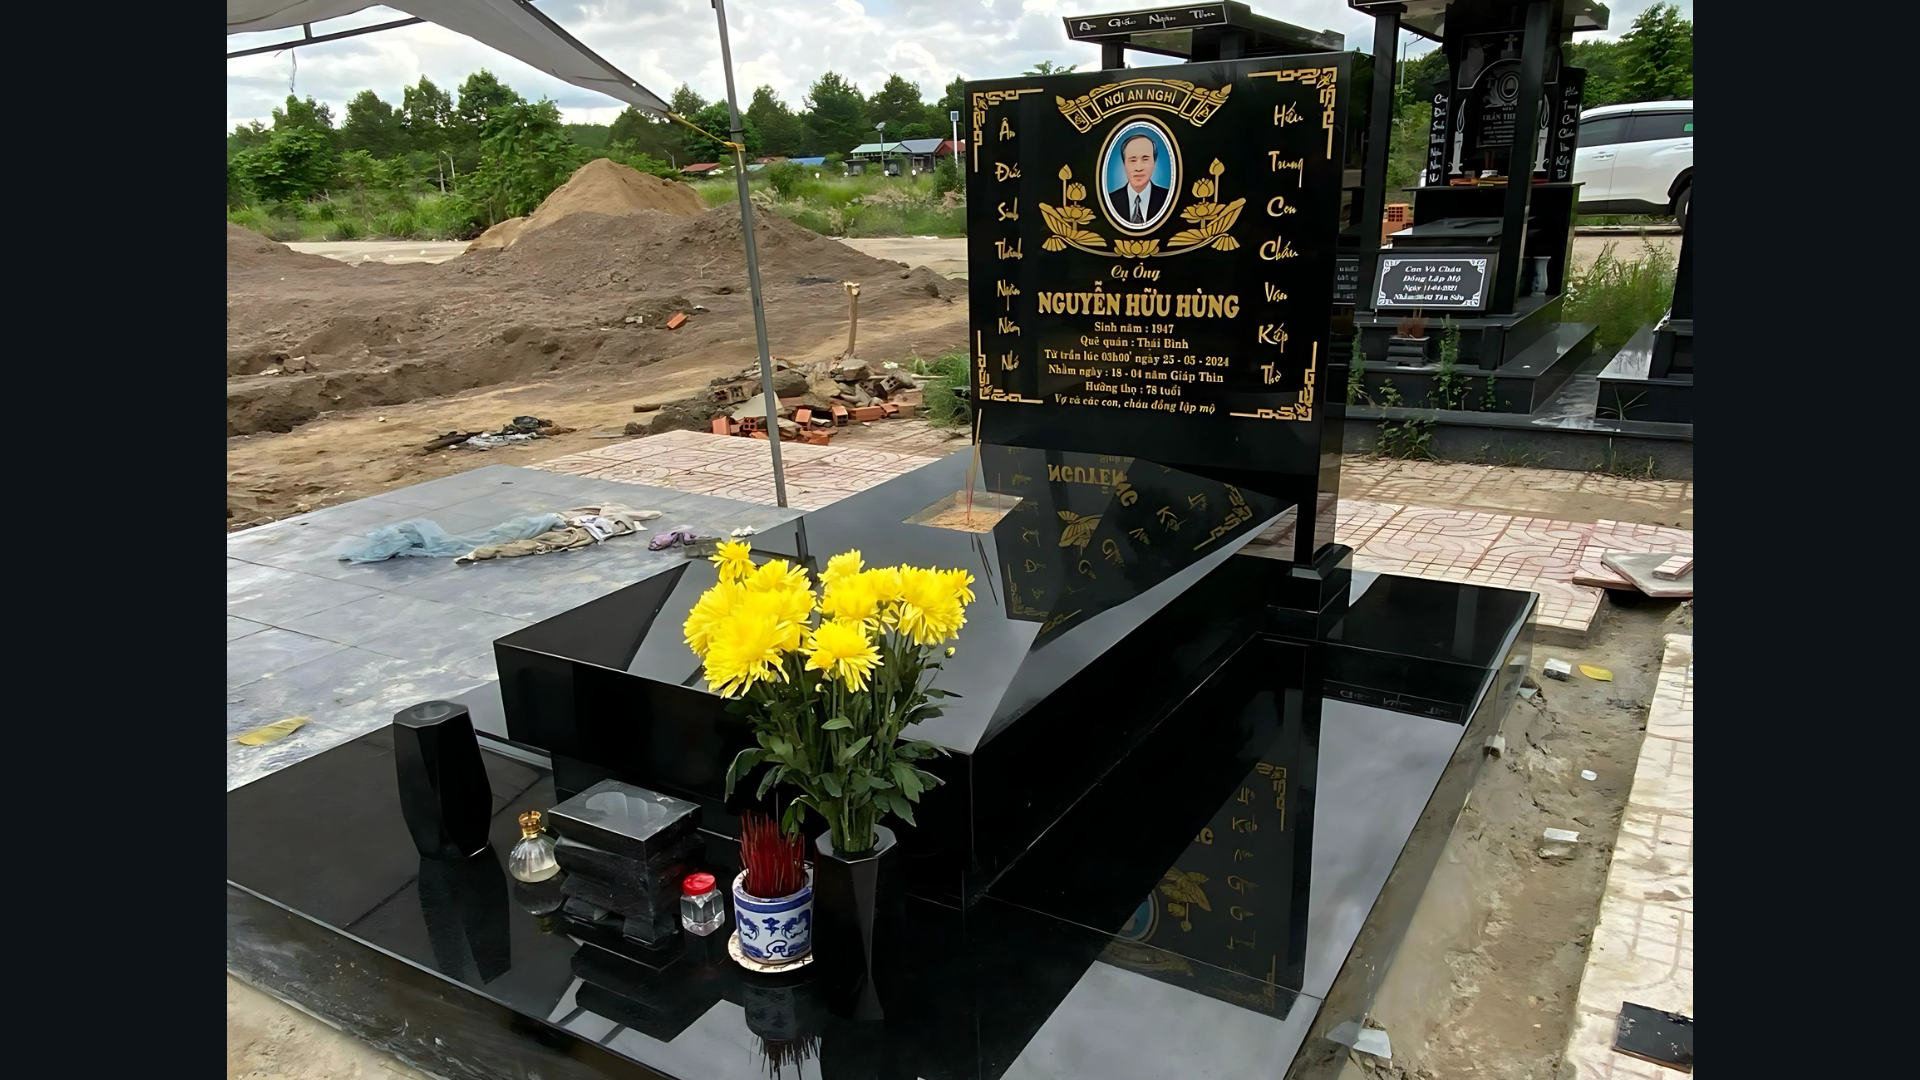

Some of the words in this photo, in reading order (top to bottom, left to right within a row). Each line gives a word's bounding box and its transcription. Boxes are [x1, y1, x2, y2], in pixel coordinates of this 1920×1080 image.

[1104, 91, 1125, 108] NƠI
[1127, 89, 1144, 101] AN
[1268, 150, 1304, 188] Trung
[1266, 196, 1297, 217] Con
[1110, 265, 1129, 282] Cụ
[1132, 262, 1161, 282] Ông
[1037, 280, 1121, 316] NGUYỄN
[1125, 287, 1172, 317] HỮU
[1175, 287, 1240, 318] HÙNG
[1094, 321, 1118, 333] Sinh
[1120, 323, 1143, 333] năm
[1151, 323, 1174, 334] 1947
[1080, 335, 1100, 347] Quê
[1102, 336, 1129, 348] quán
[1136, 337, 1161, 348] Thái
[1163, 338, 1189, 349] Bình
[1044, 348, 1058, 359] Từ
[1083, 350, 1099, 361] lúc
[1135, 353, 1160, 365] ngày
[1162, 355, 1175, 365] 25
[1183, 355, 1196, 366] 05
[1205, 356, 1230, 367] 2024
[1079, 367, 1103, 378] ngày
[1111, 368, 1122, 378] 18
[1130, 369, 1142, 379] 04
[1144, 370, 1167, 380] năm
[1170, 370, 1196, 383] Giáp
[1120, 383, 1137, 395] thọ
[1146, 385, 1157, 395] 78
[1160, 384, 1181, 396] tuổi
[1054, 393, 1067, 405] Vợ
[1069, 395, 1081, 405] và
[1082, 394, 1099, 406] các
[1101, 398, 1121, 408] con,
[1123, 398, 1149, 410] cháu
[1151, 399, 1177, 412] đồng
[1179, 401, 1197, 413] lập
[1199, 403, 1216, 415] mộ
